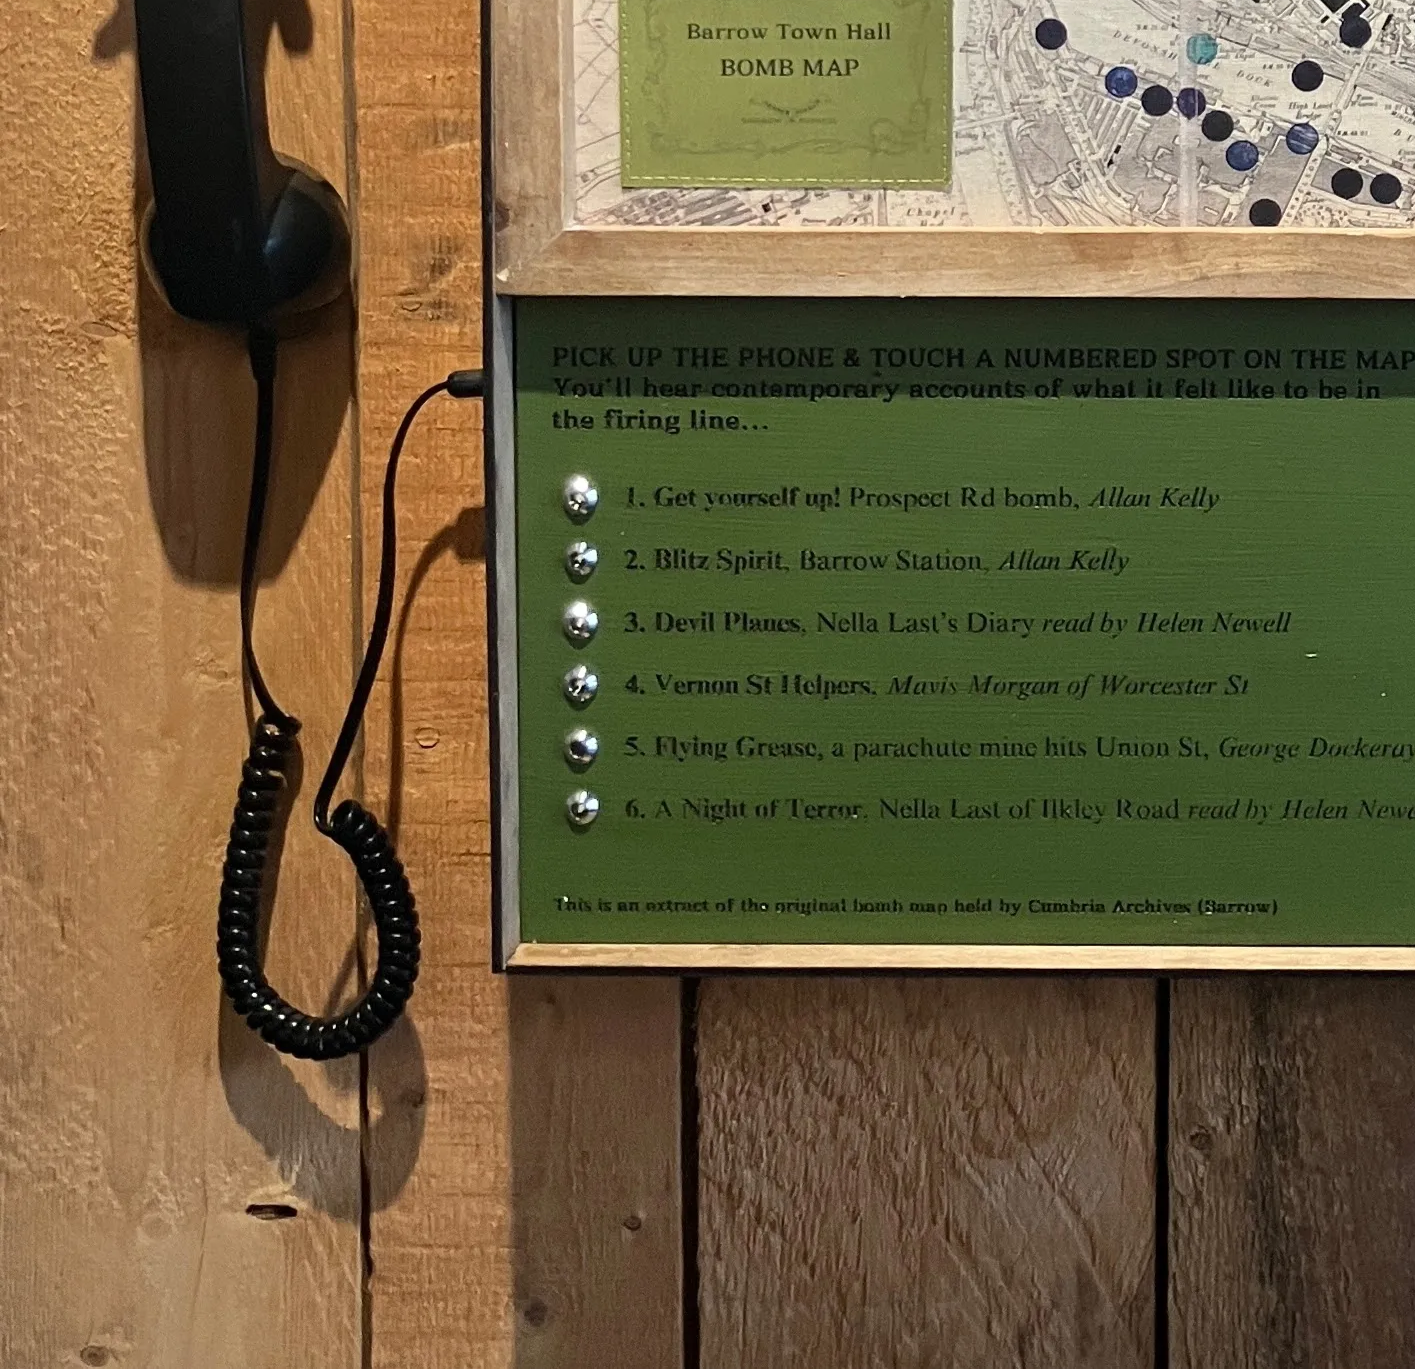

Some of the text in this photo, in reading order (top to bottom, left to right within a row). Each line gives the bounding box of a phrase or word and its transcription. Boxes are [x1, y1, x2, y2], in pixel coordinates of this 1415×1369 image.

[687, 22, 891, 40] Barrow Town Hall
[721, 58, 859, 77] BOMB MAP
[552, 346, 615, 368] PICK
[628, 346, 663, 368] UP
[676, 347, 728, 369] THE
[739, 346, 834, 369] PHONE
[842, 348, 860, 368] &
[871, 346, 965, 370] TOUCH
[975, 348, 995, 368] A
[1004, 347, 1157, 369] NUMBERED
[1166, 347, 1236, 370] SPOT
[1243, 349, 1281, 370] ON
[1291, 349, 1347, 371] THE
[552, 376, 1383, 404] You'll hear contemporary accounts of what it felt like to be in
[551, 408, 594, 430] the
[604, 408, 681, 435] firing
[626, 486, 646, 509] 1.
[653, 485, 696, 508] Get
[703, 485, 801, 513] yourself
[805, 485, 841, 513] up!
[849, 486, 949, 513] Prospect
[960, 486, 995, 508] Rd
[1089, 485, 1151, 508] Allan
[1160, 485, 1221, 514] Kelly
[623, 611, 646, 634] 3.
[655, 610, 715, 633] Devil
[816, 611, 878, 634] Nella
[888, 611, 958, 635] Last's
[967, 611, 1034, 639] Diary
[1042, 611, 1096, 634] read
[1099, 610, 1128, 640] by
[1137, 611, 1204, 634] Helen
[1212, 611, 1292, 634] Newell
